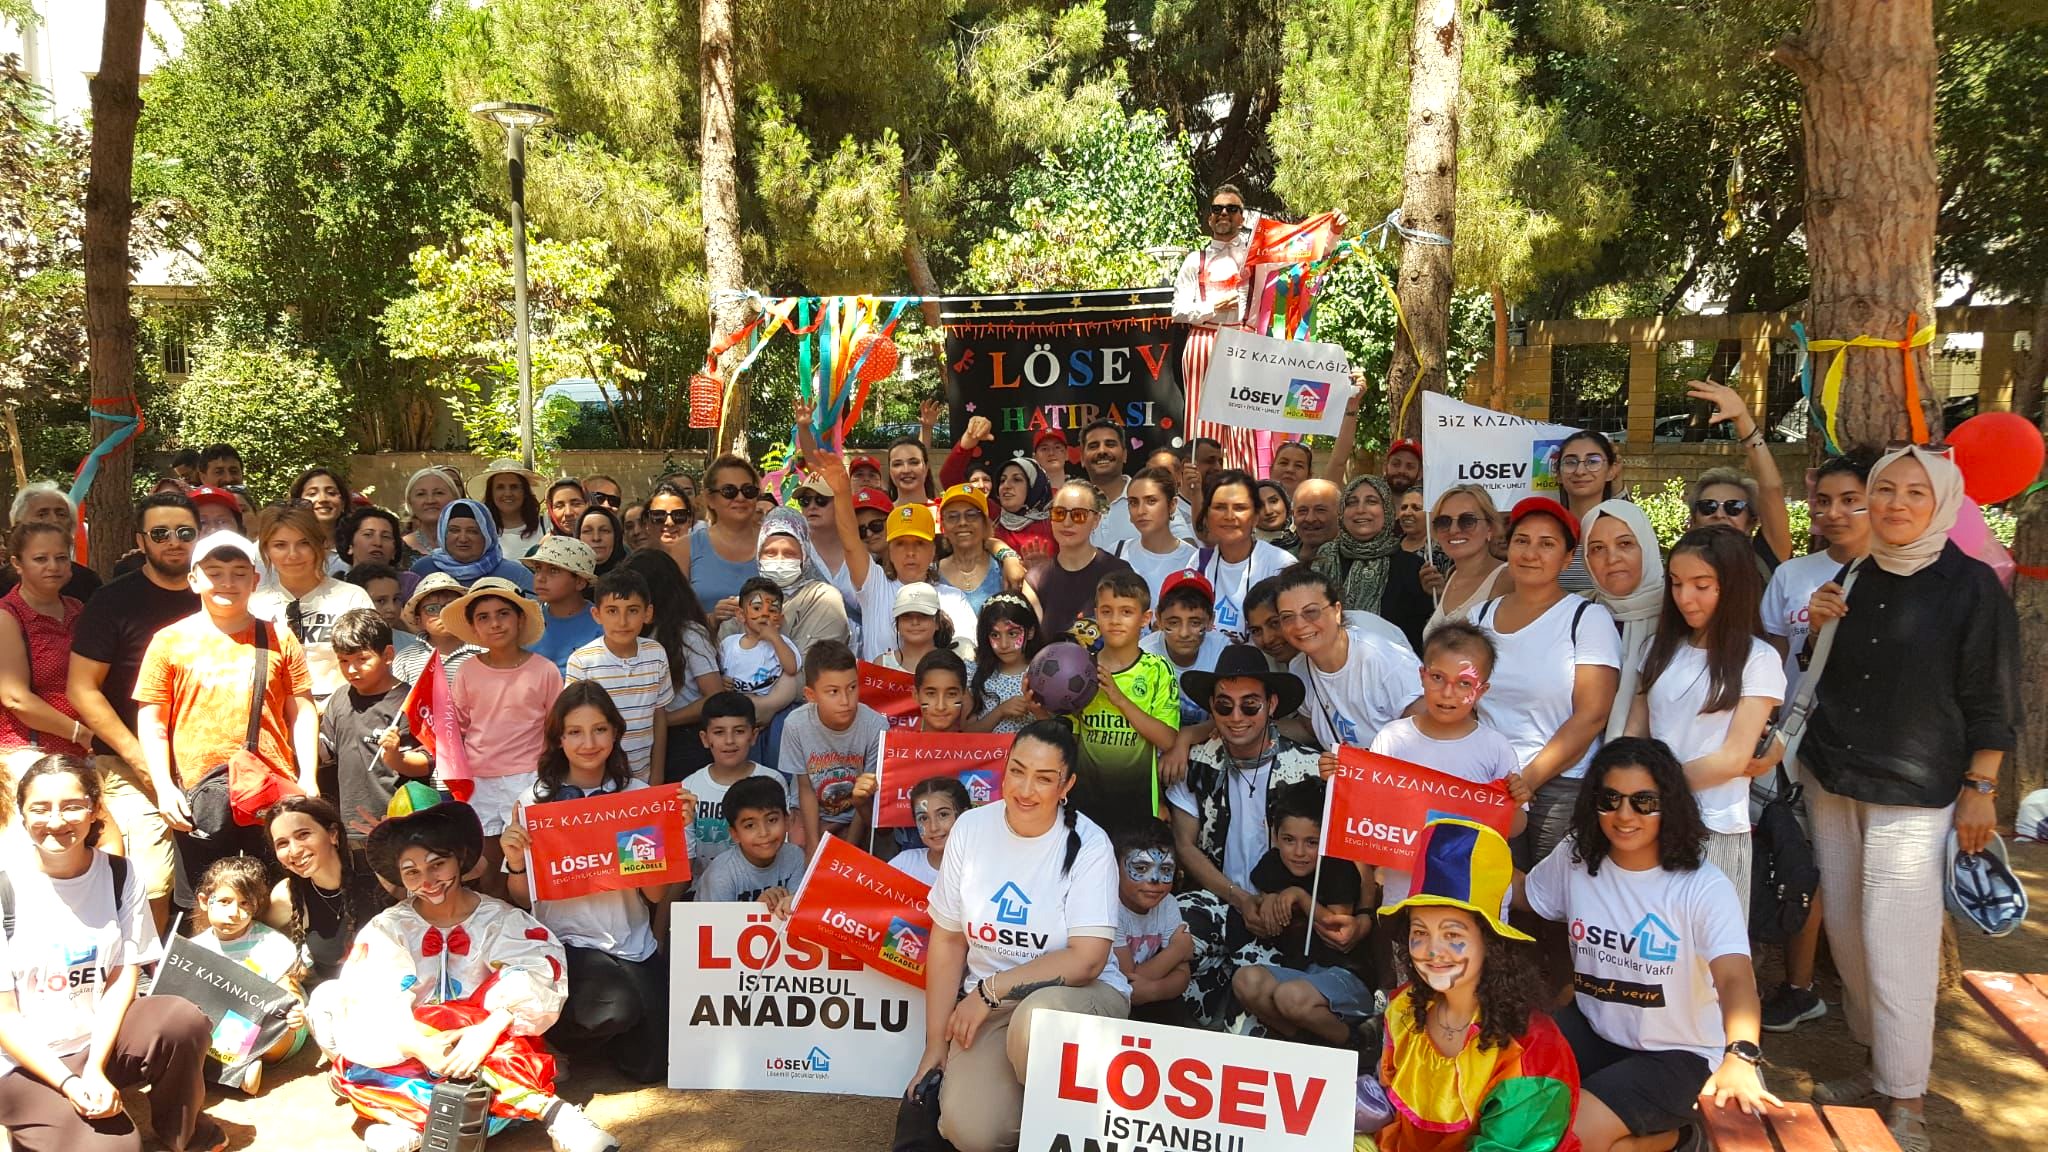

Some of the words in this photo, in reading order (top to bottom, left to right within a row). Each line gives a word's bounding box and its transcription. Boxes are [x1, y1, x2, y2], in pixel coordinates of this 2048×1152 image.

[988, 344, 1171, 388] LÖSEV
[1252, 352, 1349, 374] KAZANACAĞIZ
[1230, 386, 1284, 407] LÖSEV
[1001, 402, 1155, 432] HATIRASI
[1458, 461, 1528, 480] LÖSEV
[1100, 730, 1138, 747] BETTER
[915, 747, 1008, 761] KAZANACAĞI
[1372, 770, 1505, 807] KAZANACAĞIZ
[561, 800, 677, 827] KAZANACAĞIZ
[1346, 817, 1419, 846] LÖSEV
[550, 852, 613, 876] LÖSEV
[624, 862, 663, 872] MÜCADELE
[821, 908, 880, 942] LÖSEV
[967, 921, 1049, 950] LÖSEV
[1571, 917, 1637, 954] ÖSEV
[698, 914, 864, 972] LÖS
[997, 946, 1030, 958] Çocuklar
[883, 950, 920, 971] MÜCADELE
[1598, 950, 1643, 972] Çocuklar
[1645, 963, 1674, 976] Vakfı
[195, 966, 287, 1018] KAZANACAIZ
[738, 971, 856, 996] İSTANBUL
[689, 995, 909, 1033] ANADOLU
[766, 1057, 811, 1070] LÖSEV
[1057, 1035, 1328, 1137] LÖSEV
